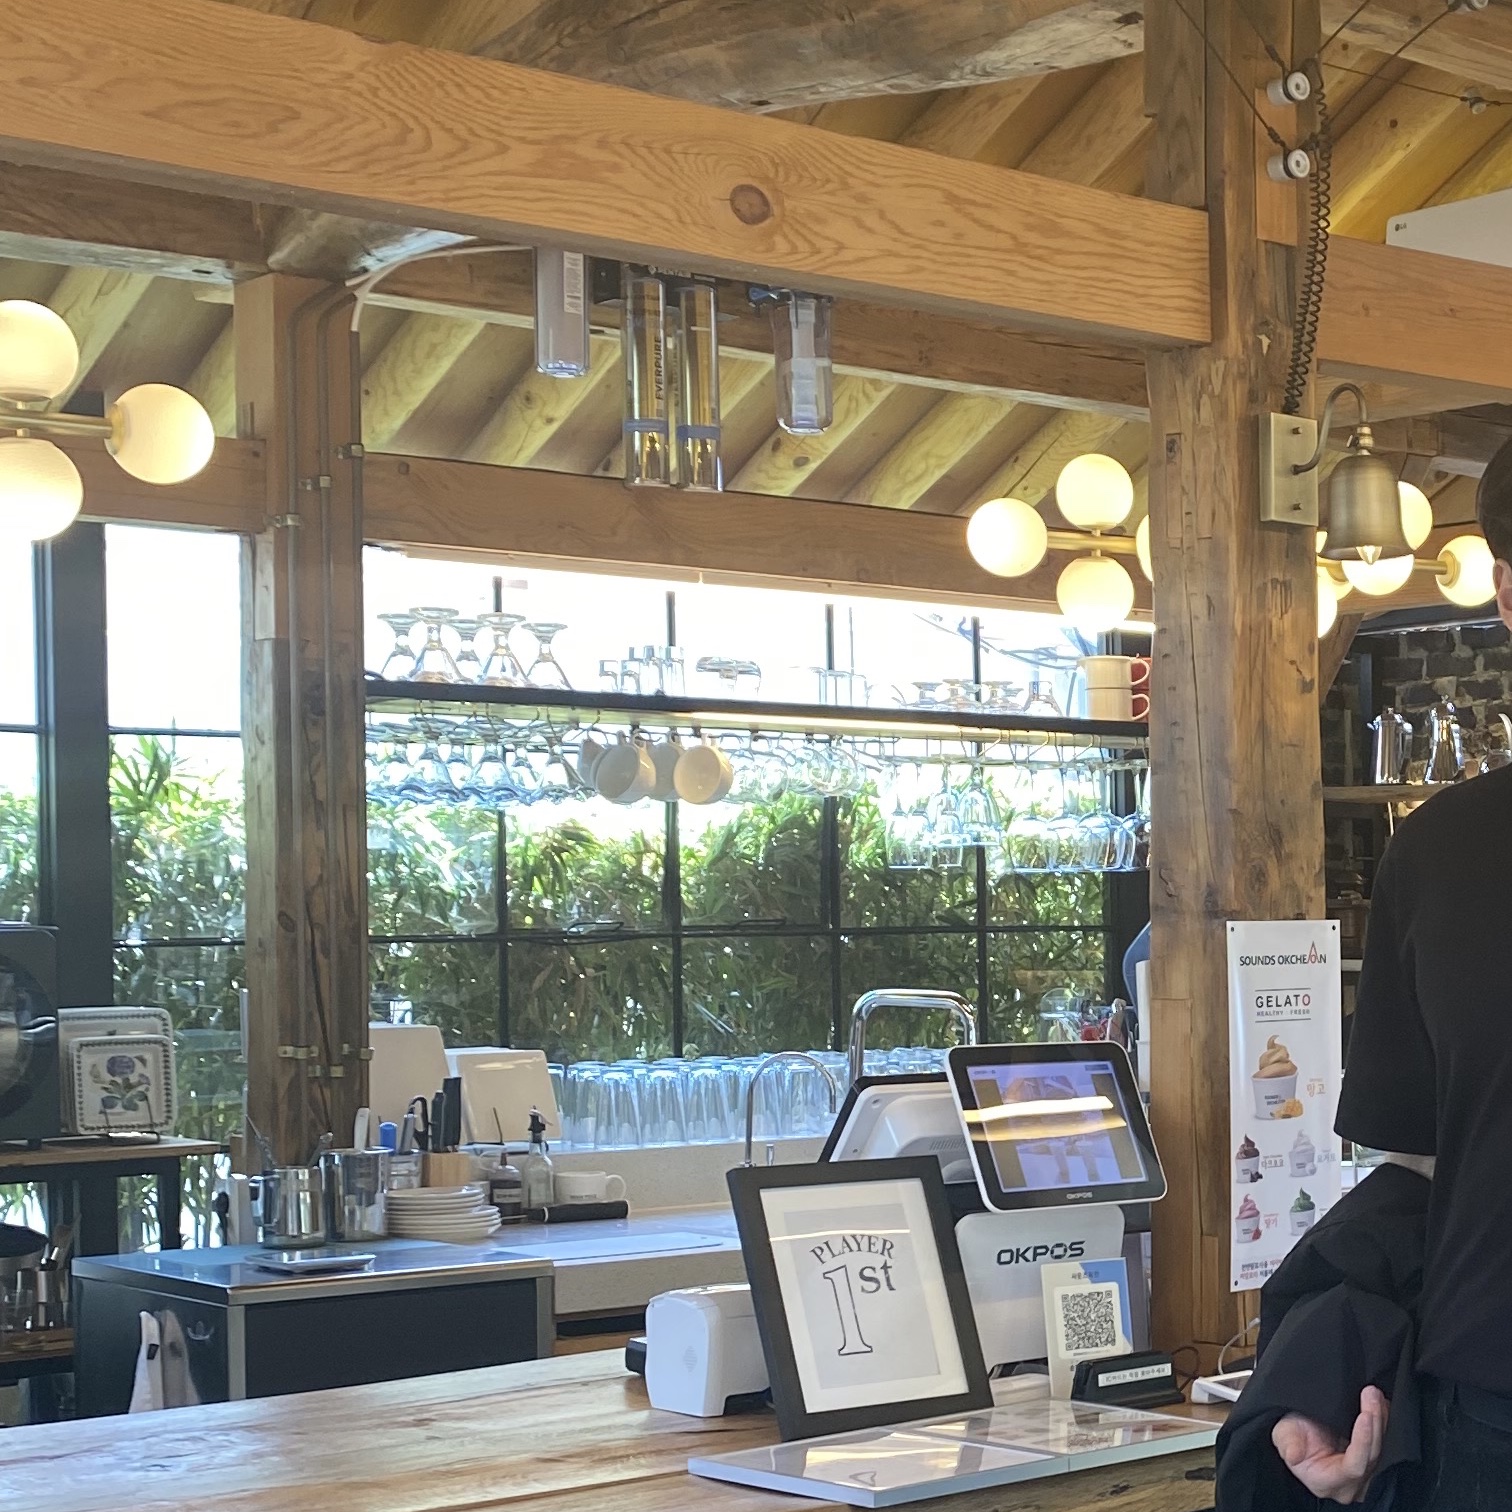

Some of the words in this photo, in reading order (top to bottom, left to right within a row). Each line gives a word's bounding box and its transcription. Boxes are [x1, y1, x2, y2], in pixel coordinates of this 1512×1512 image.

[1240, 955, 1275, 966] SOUNDS
[1255, 994, 1311, 1008] GELATO
[1066, 1191, 1093, 1200] OKPOS
[809, 1233, 895, 1265] PLAYER
[996, 1240, 1085, 1265] OKPOS
